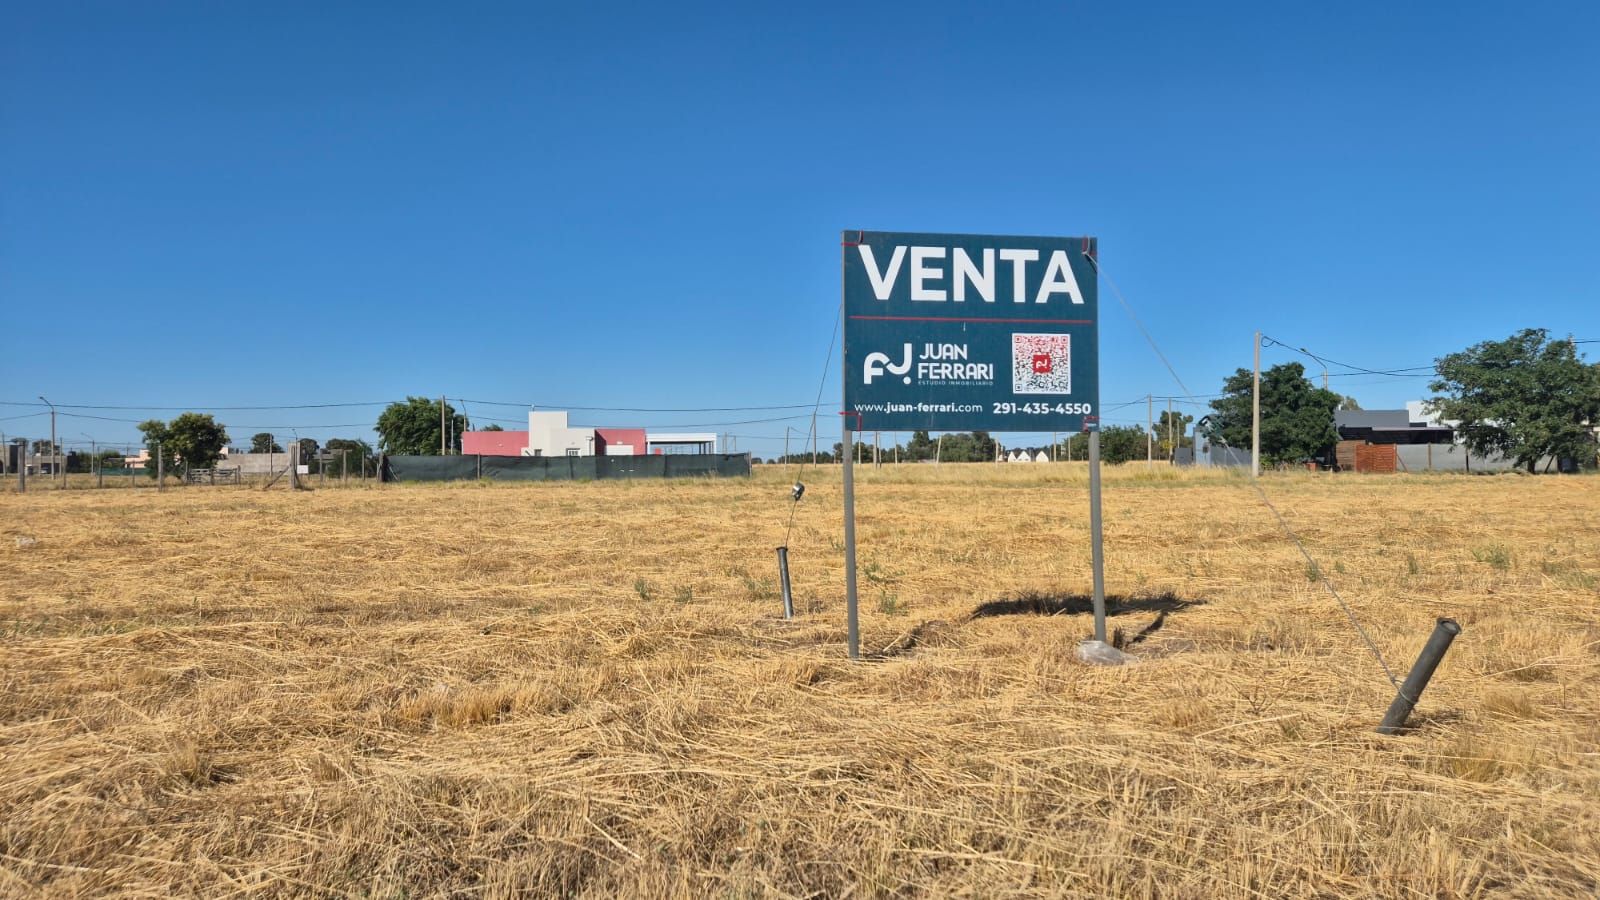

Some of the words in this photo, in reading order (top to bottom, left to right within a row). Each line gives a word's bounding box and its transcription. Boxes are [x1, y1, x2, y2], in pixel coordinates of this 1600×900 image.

[858, 244, 1085, 305] VENTA
[919, 343, 968, 360] JUAN
[918, 363, 994, 380] FERRARI
[854, 402, 983, 414] www.juan-ferrari.com
[993, 402, 1092, 415] 291-435-4550
